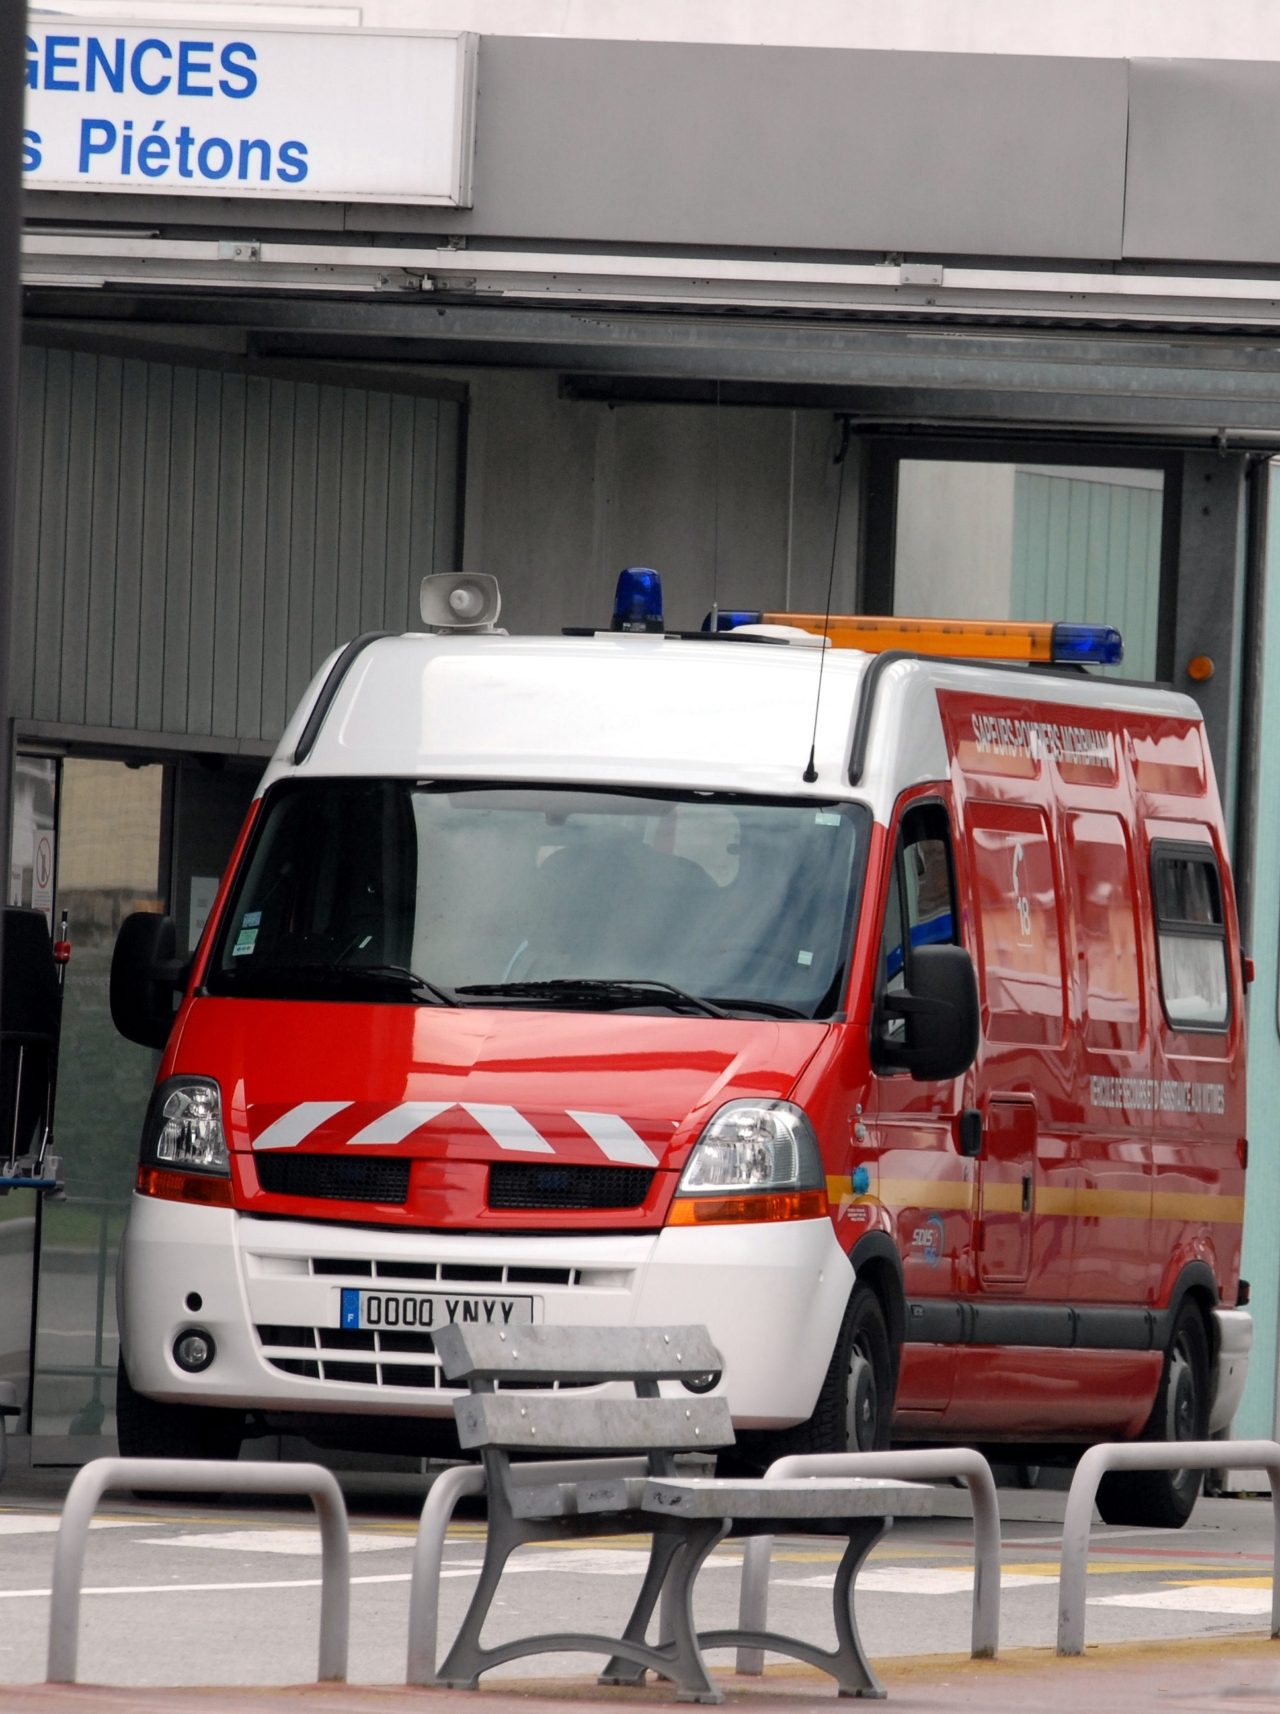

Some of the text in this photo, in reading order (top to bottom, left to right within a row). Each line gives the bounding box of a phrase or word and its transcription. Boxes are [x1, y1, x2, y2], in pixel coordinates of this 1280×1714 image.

[79, 118, 308, 182] Piétons
[1017, 896, 1031, 936] 18
[347, 1313, 354, 1322] F
[445, 1299, 514, 1324] YNYY
